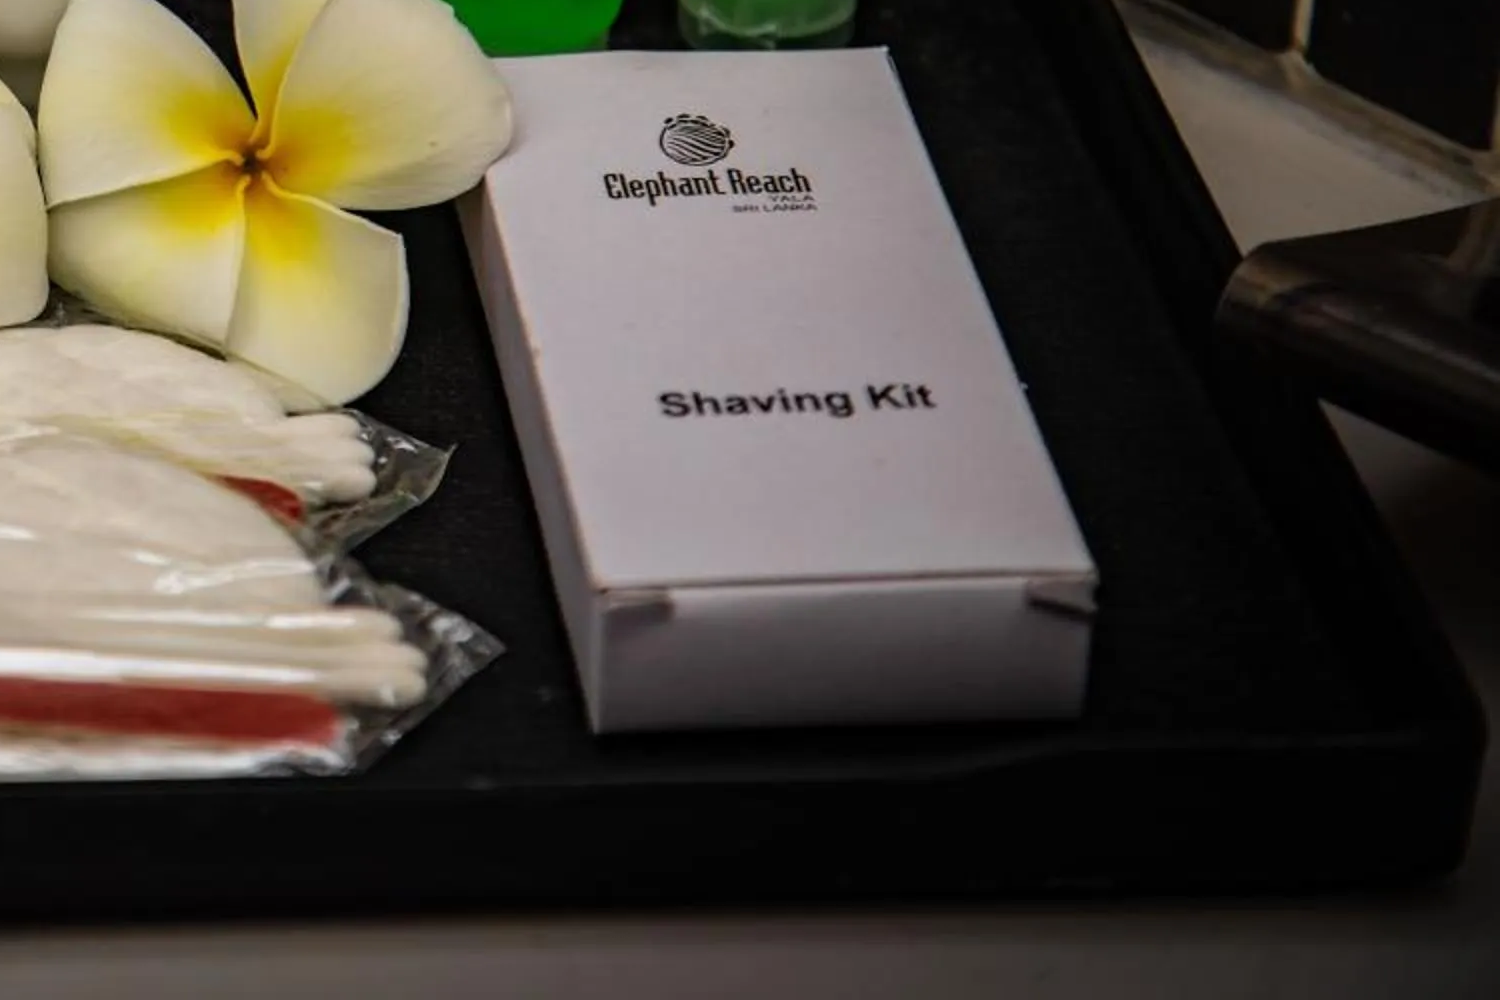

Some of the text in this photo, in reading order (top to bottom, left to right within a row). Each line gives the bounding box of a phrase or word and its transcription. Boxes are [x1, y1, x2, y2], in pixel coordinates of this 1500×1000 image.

[603, 167, 812, 207] Elephant Reach
[658, 382, 938, 418] Shaving Kit
